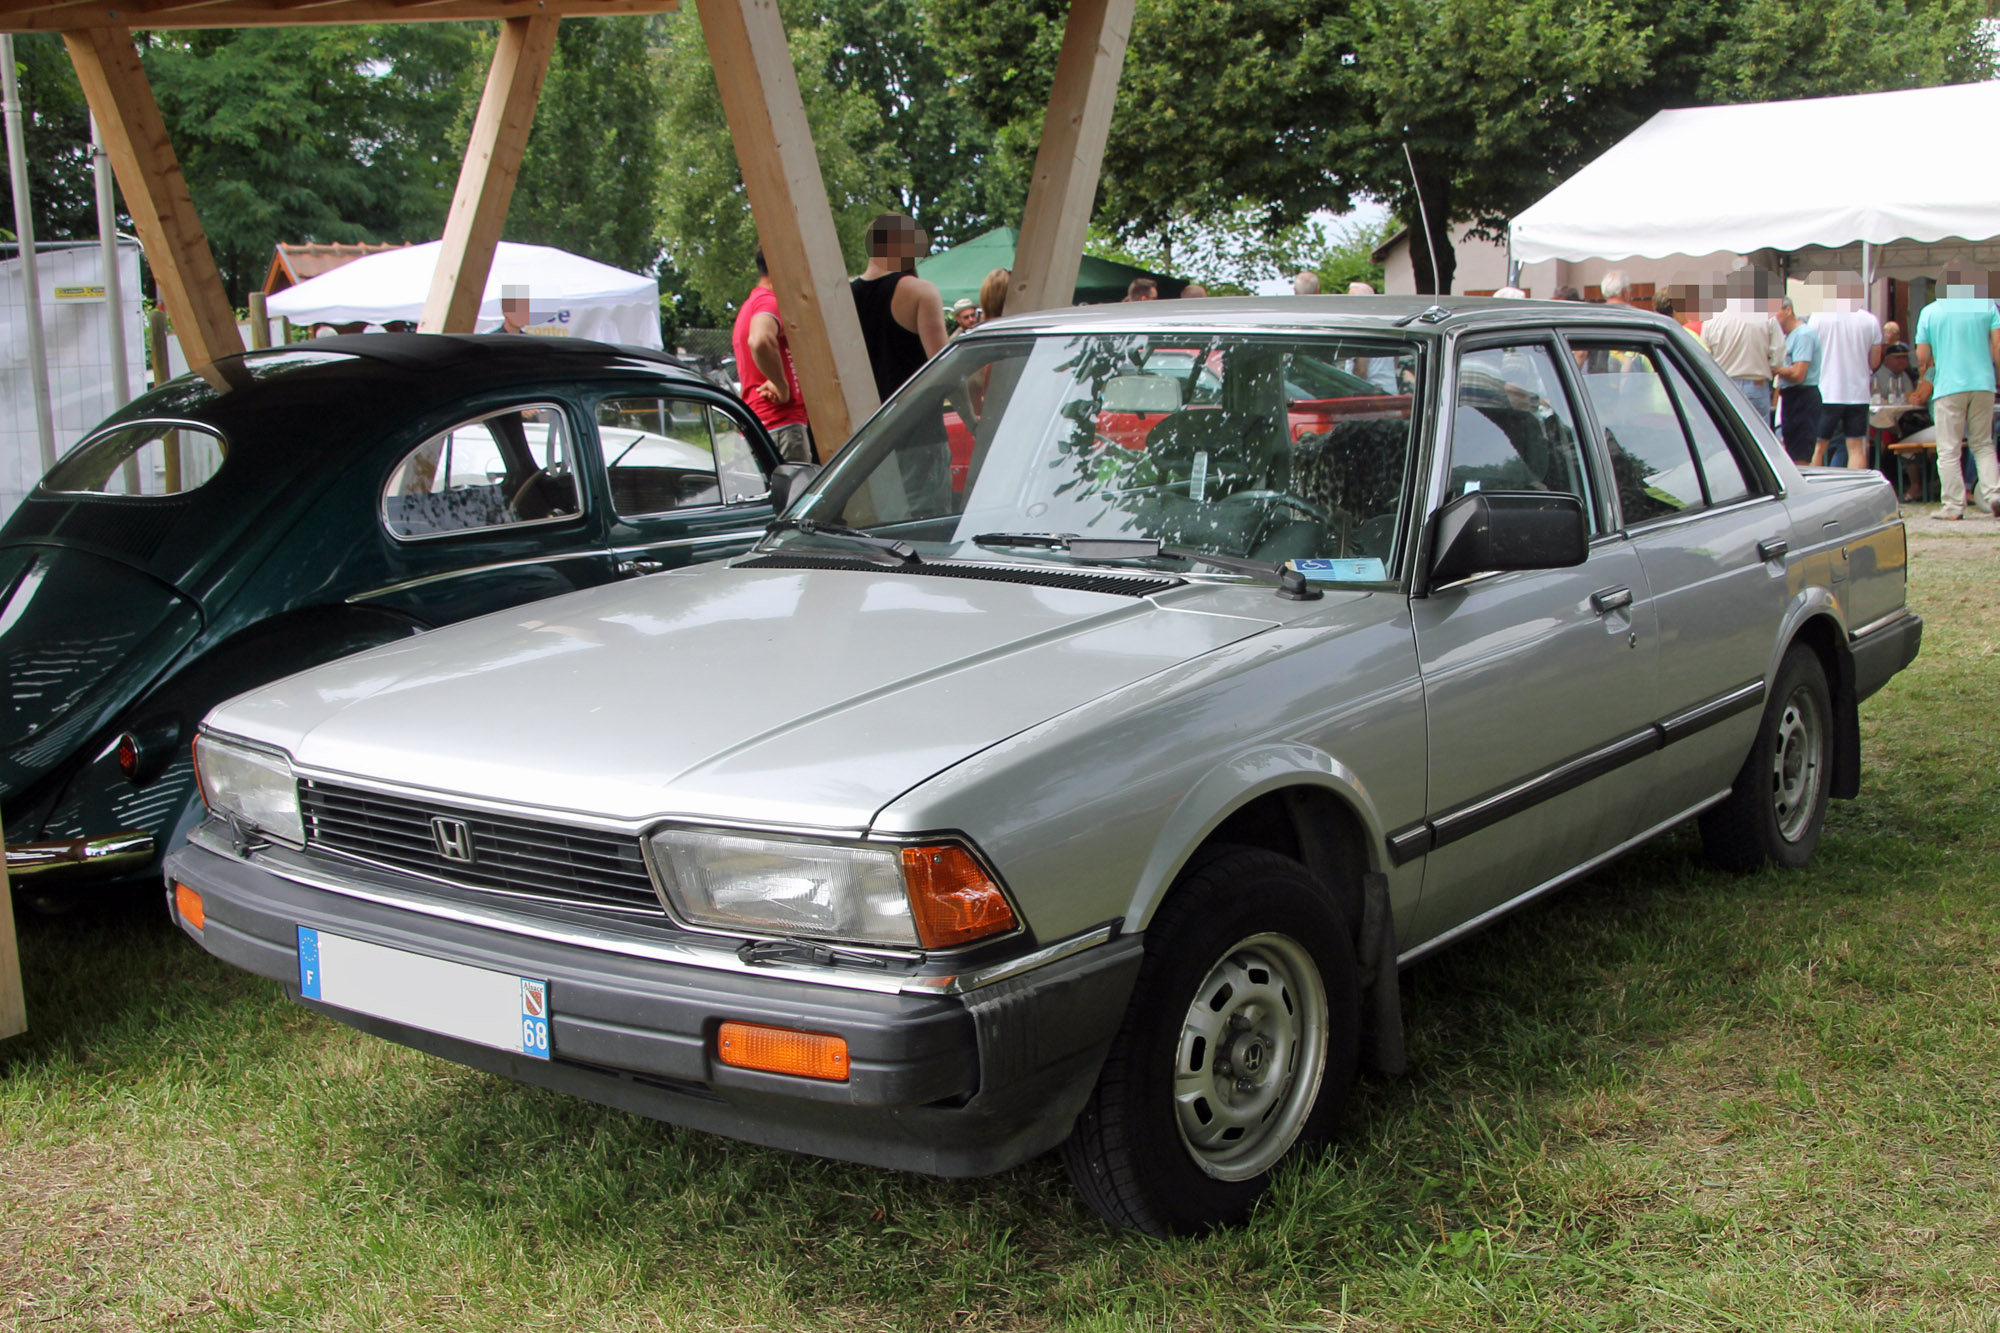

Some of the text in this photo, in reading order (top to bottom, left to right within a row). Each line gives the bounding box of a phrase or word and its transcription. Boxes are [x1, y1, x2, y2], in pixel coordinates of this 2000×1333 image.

[306, 969, 314, 985] F
[523, 981, 544, 992] Alsace
[523, 1019, 547, 1050] 68
